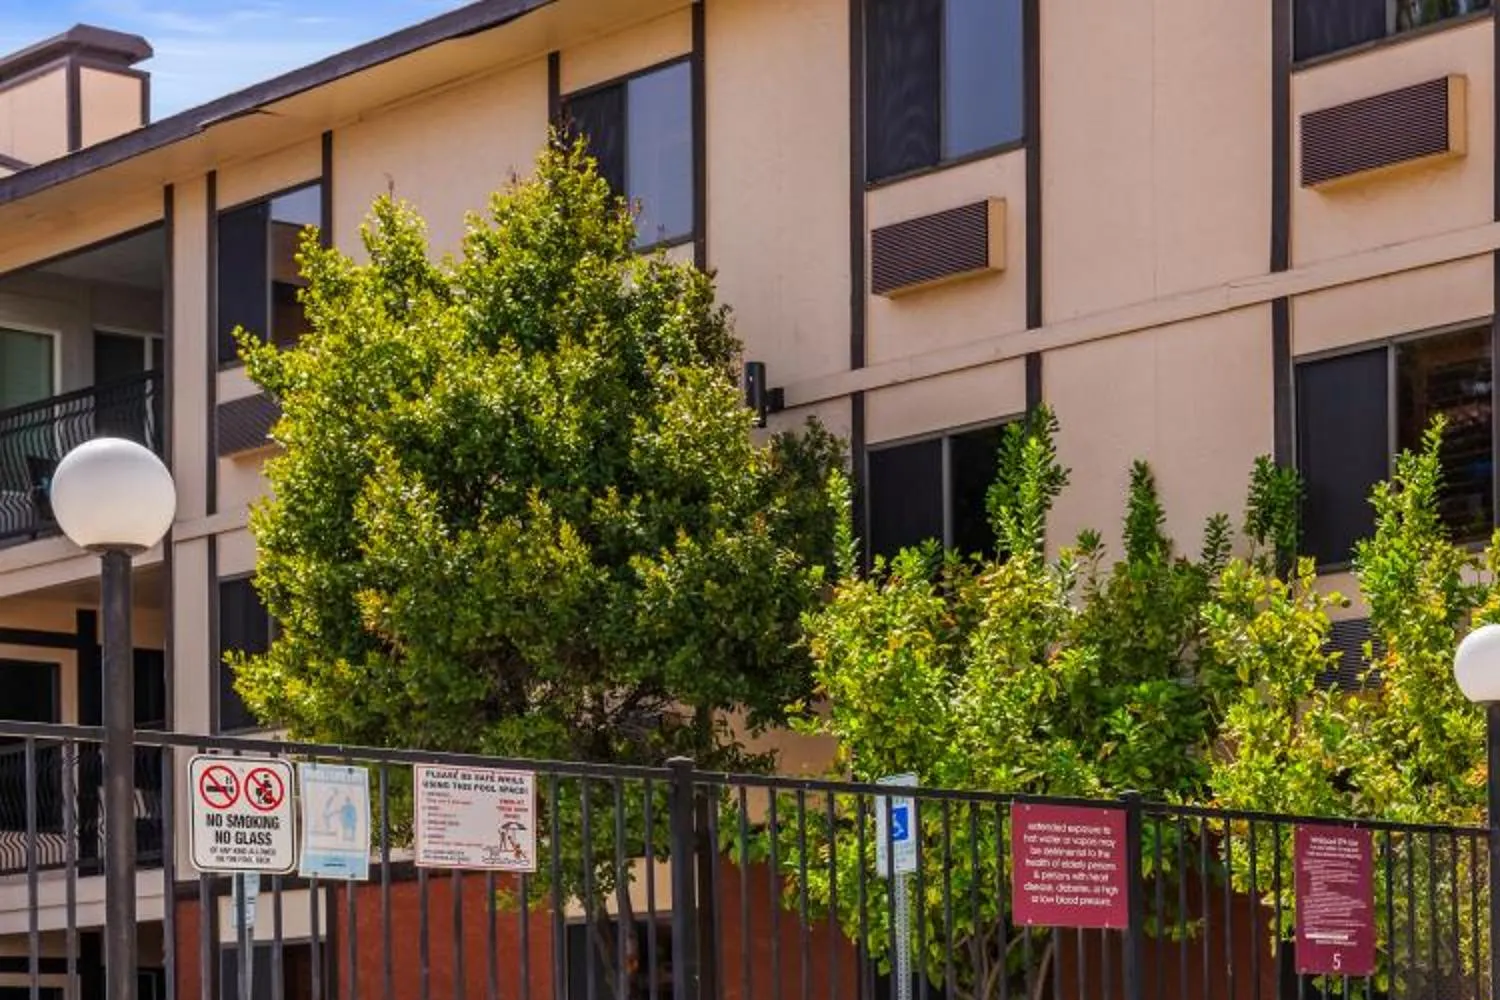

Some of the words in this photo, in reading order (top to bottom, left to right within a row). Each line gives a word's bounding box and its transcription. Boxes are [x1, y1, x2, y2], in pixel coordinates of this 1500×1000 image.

[206, 813, 223, 828] NO
[226, 813, 280, 829] SMOKING
[215, 831, 231, 845] NO
[235, 831, 273, 846] GLASS
[1332, 953, 1341, 971] 5
